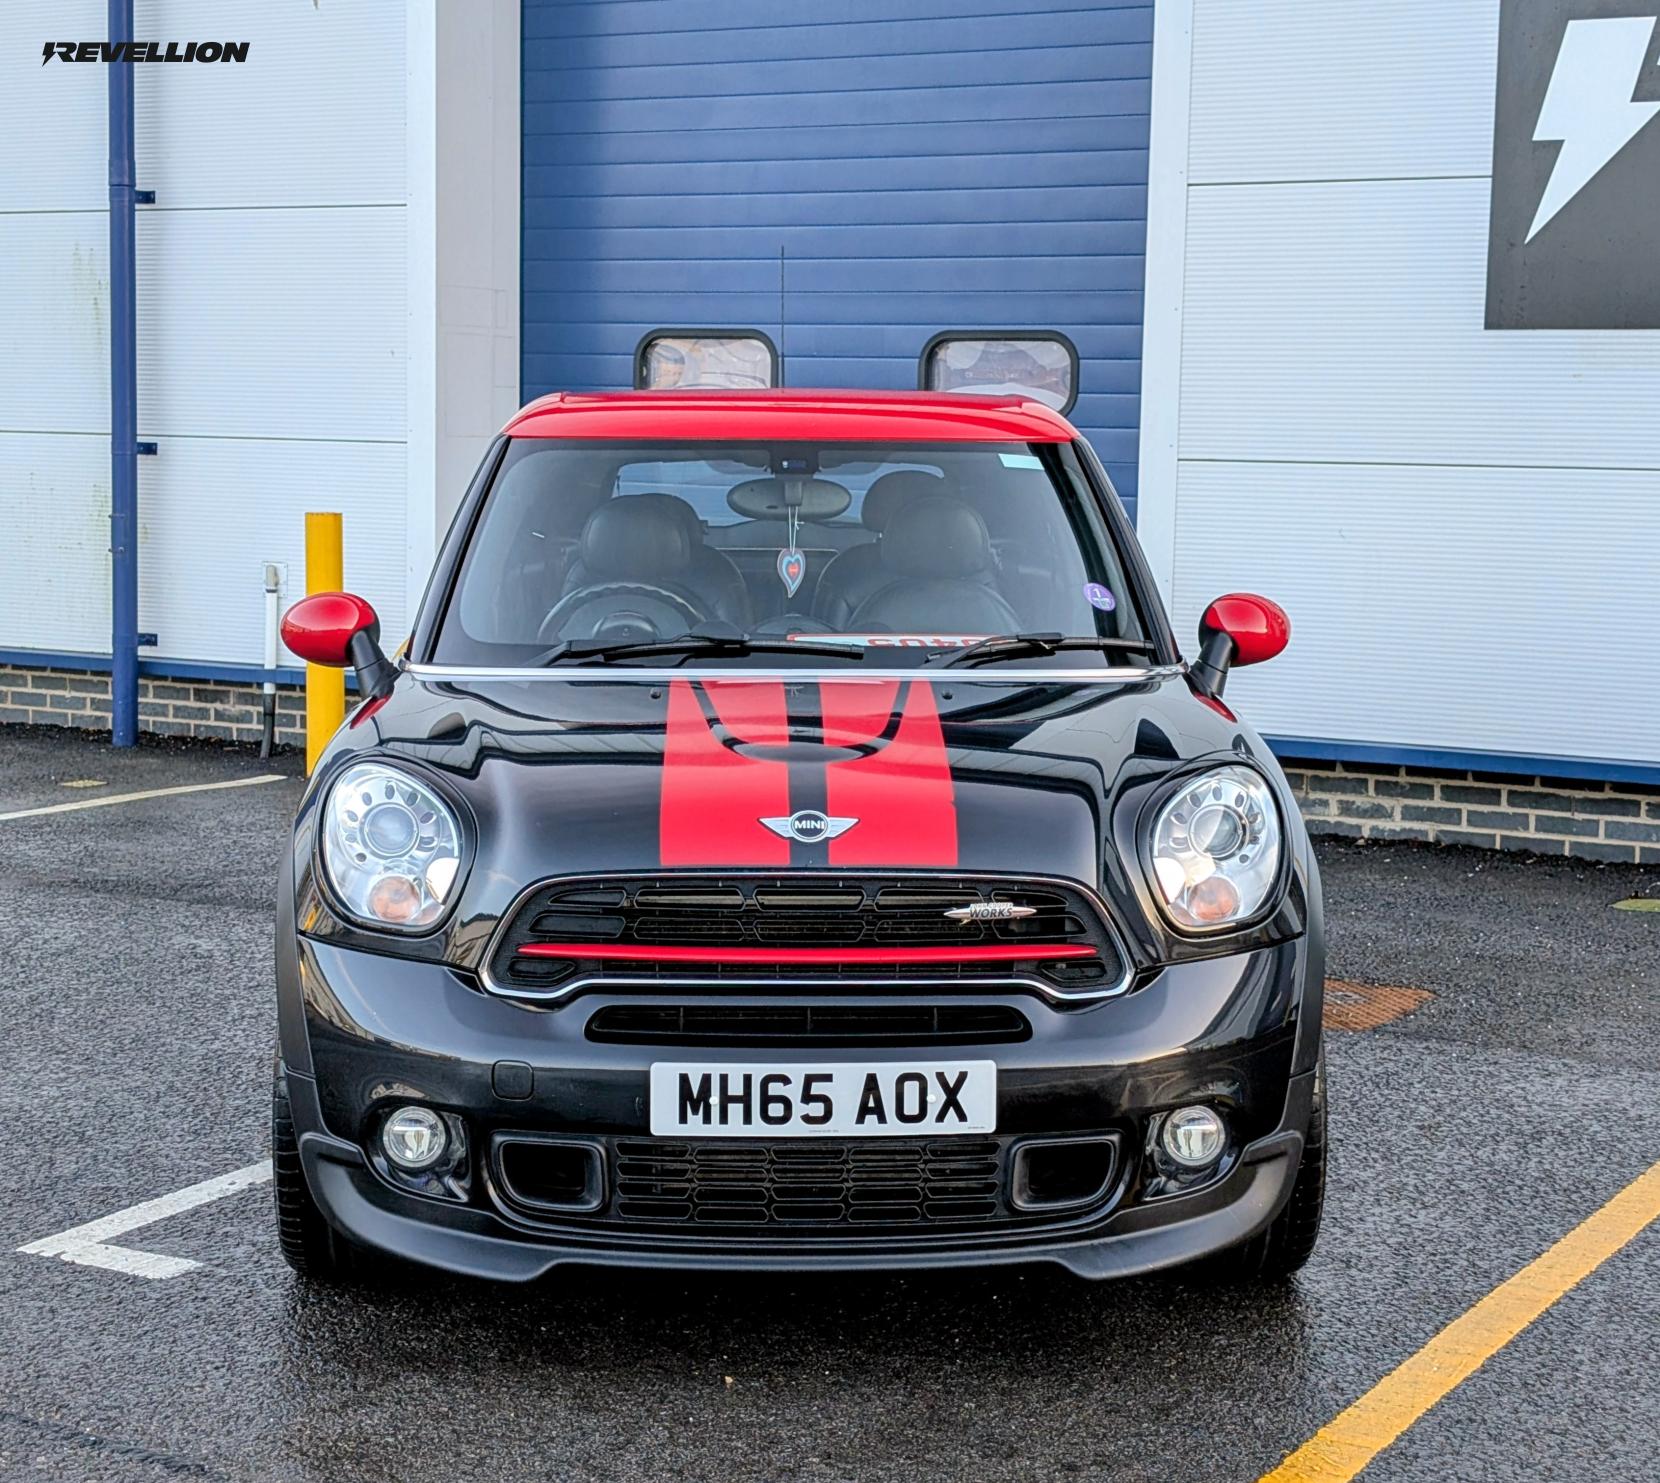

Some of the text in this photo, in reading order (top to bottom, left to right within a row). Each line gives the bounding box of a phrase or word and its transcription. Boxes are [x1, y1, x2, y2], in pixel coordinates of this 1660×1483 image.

[794, 820, 825, 829] MINI
[969, 907, 1013, 918] WORKS
[678, 1071, 968, 1125] MH65 AOX
